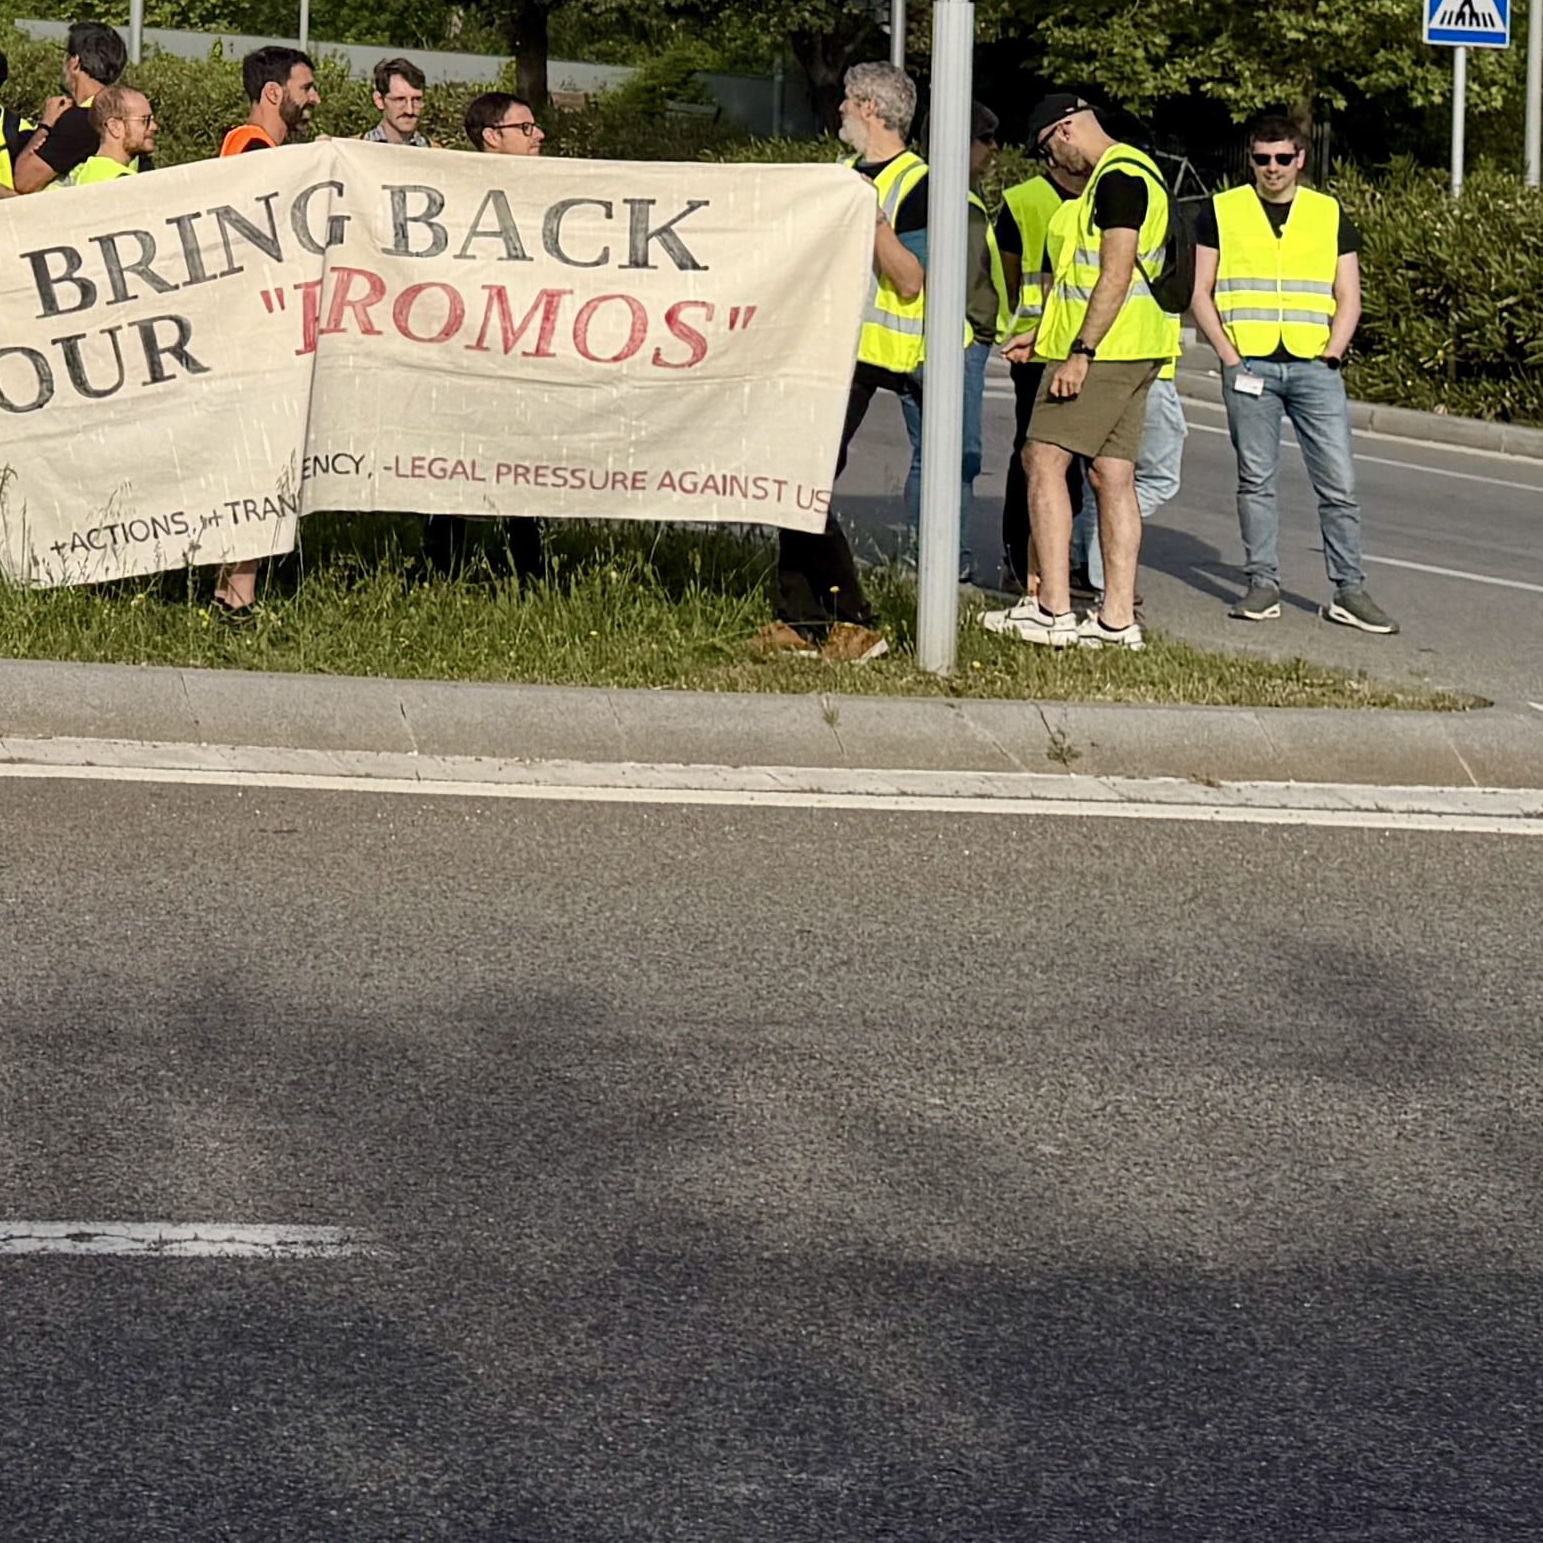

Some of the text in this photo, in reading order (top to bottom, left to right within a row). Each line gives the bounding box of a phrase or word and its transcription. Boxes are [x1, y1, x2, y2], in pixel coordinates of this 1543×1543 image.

[19, 179, 710, 319] BRING BACK
[495, 463, 648, 492] PRESSURE
[656, 470, 789, 503] AGAINST
